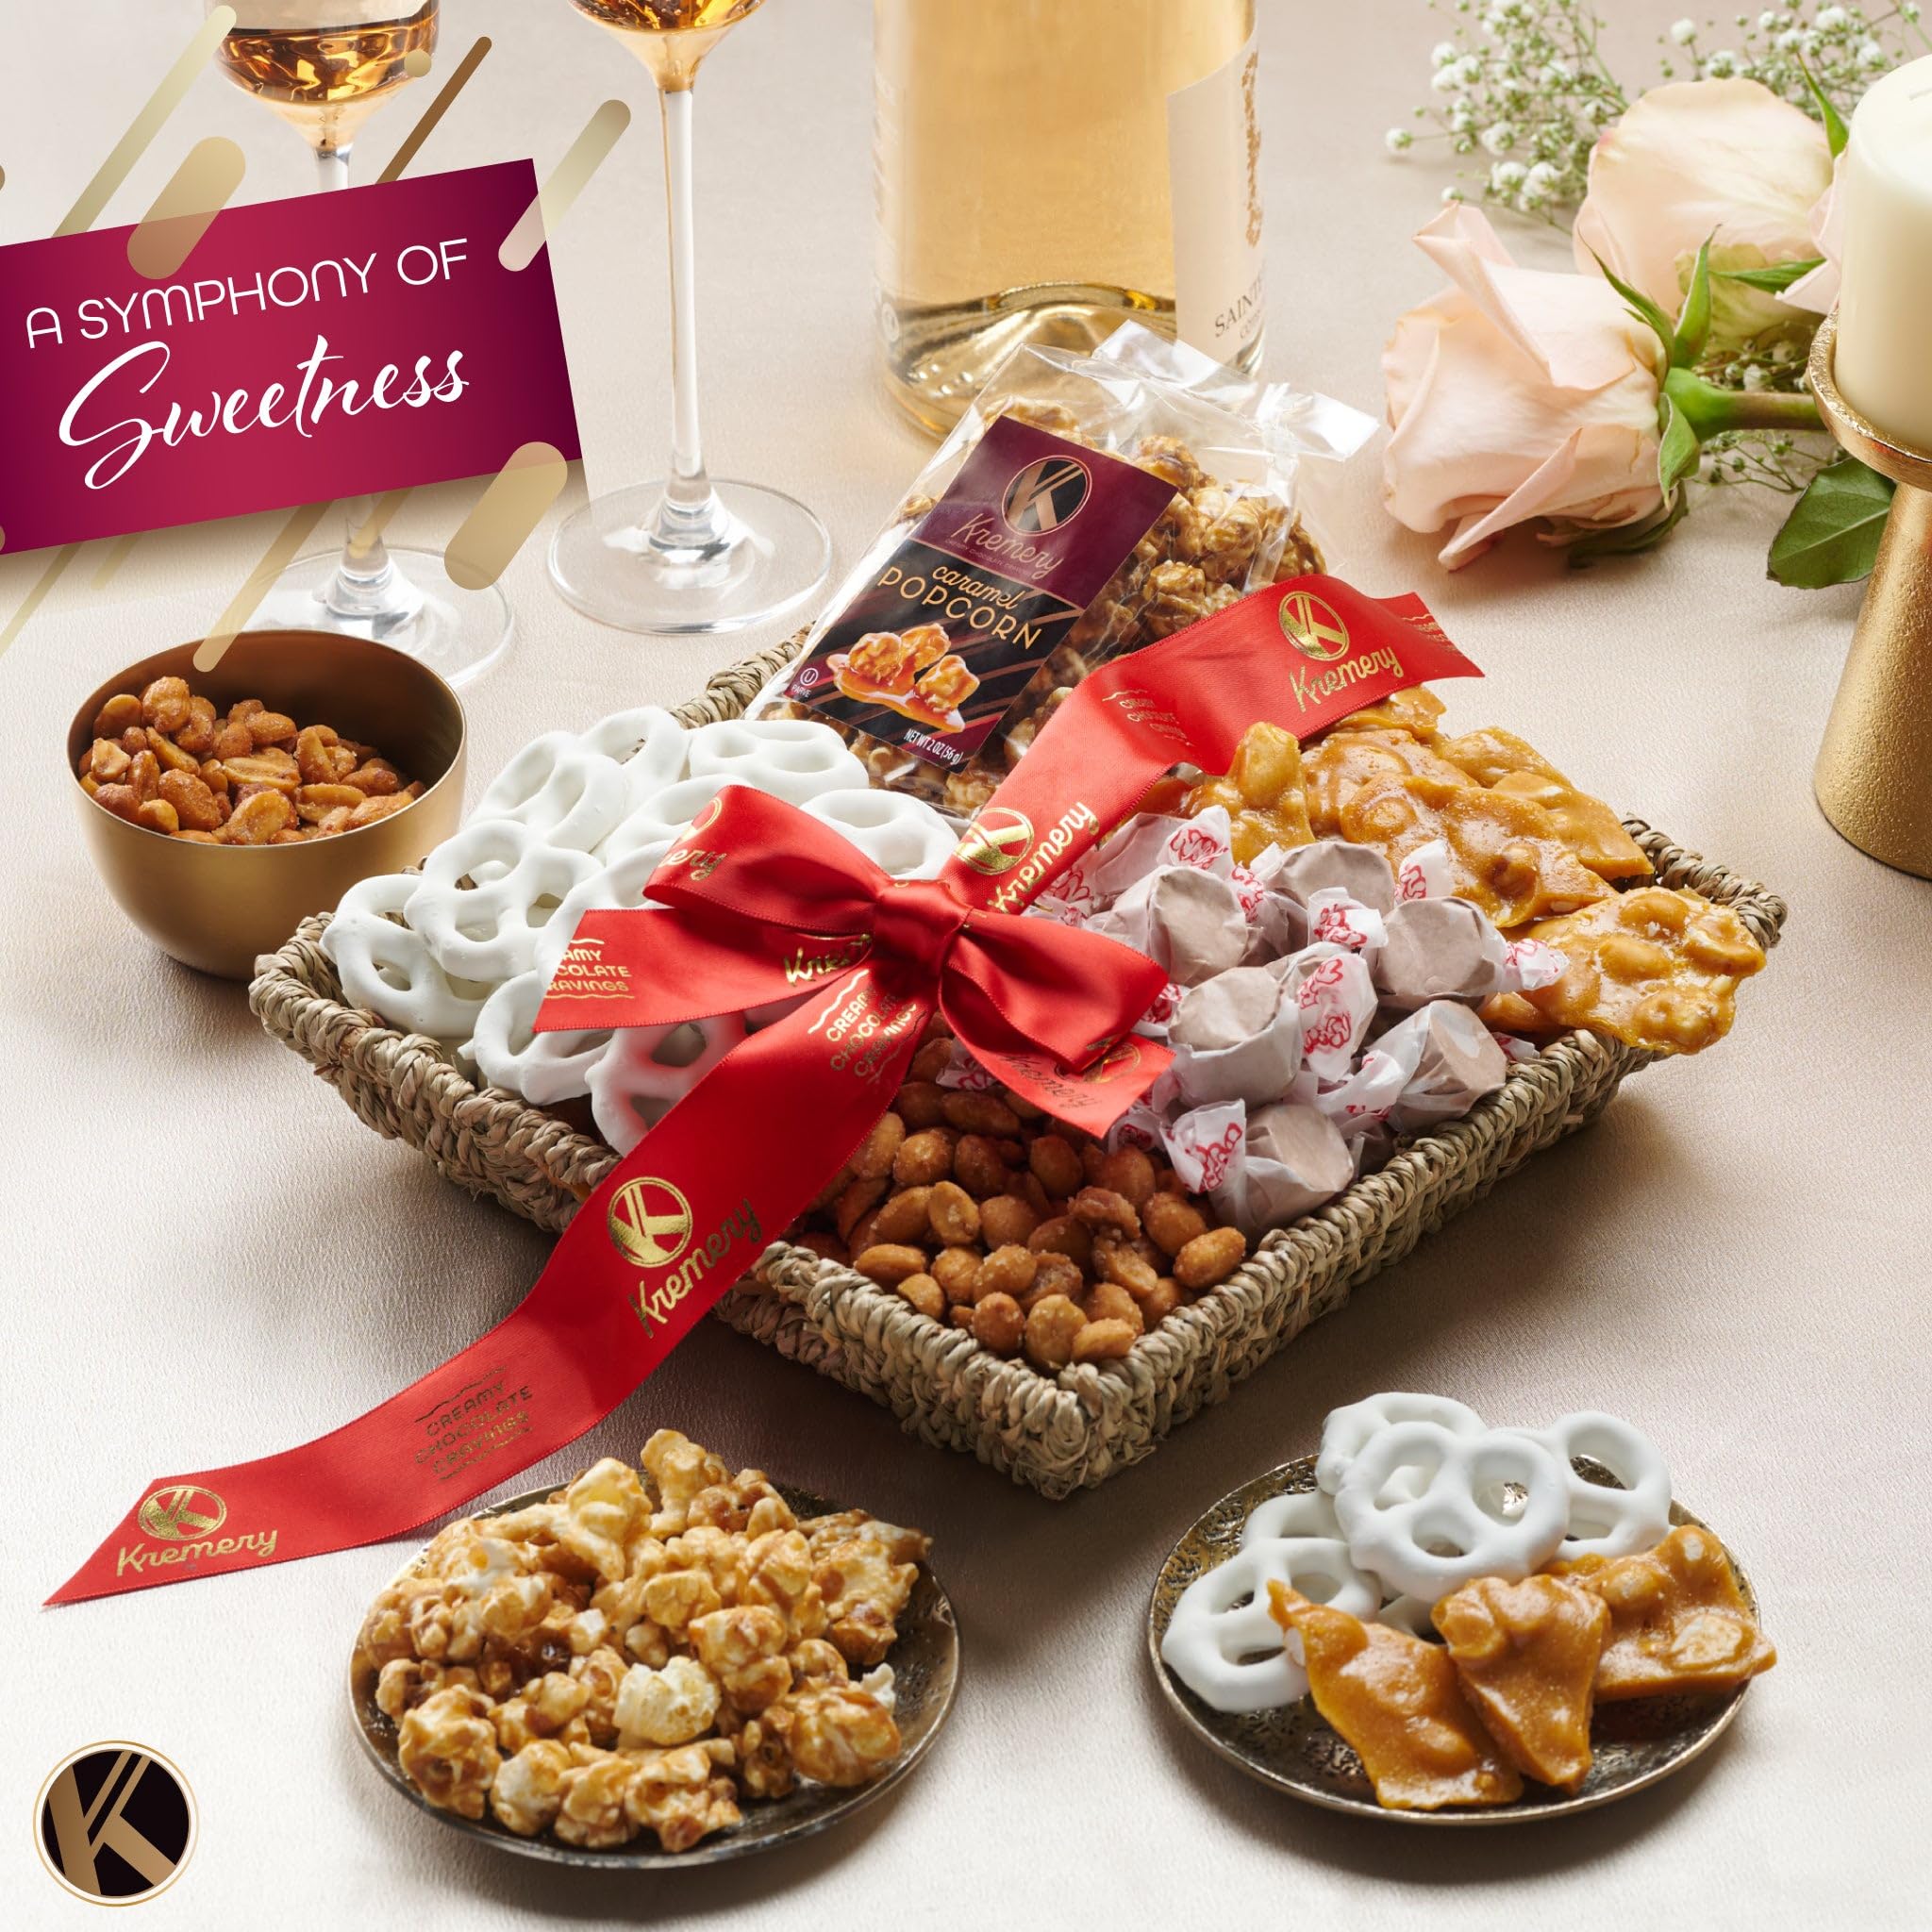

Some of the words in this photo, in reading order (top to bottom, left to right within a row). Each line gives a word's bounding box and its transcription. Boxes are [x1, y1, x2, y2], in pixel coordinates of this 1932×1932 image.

[950, 513, 1064, 579] Kremery
[877, 566, 1042, 650] POPCORN
[931, 565, 1023, 611] caramel
[1289, 646, 1404, 712] Kremery
[904, 728, 920, 743] NET
[916, 734, 931, 748] WT
[926, 739, 936, 751] 2
[932, 741, 945, 755] OZ
[987, 802, 1100, 914] Kremery
[627, 1199, 763, 1339] Kremery
[415, 1386, 533, 1464] CHOCOLATE
[426, 1380, 505, 1437] CREAMY
[433, 1411, 529, 1474] CRAVINGS
[117, 1529, 278, 1576] Kremery
